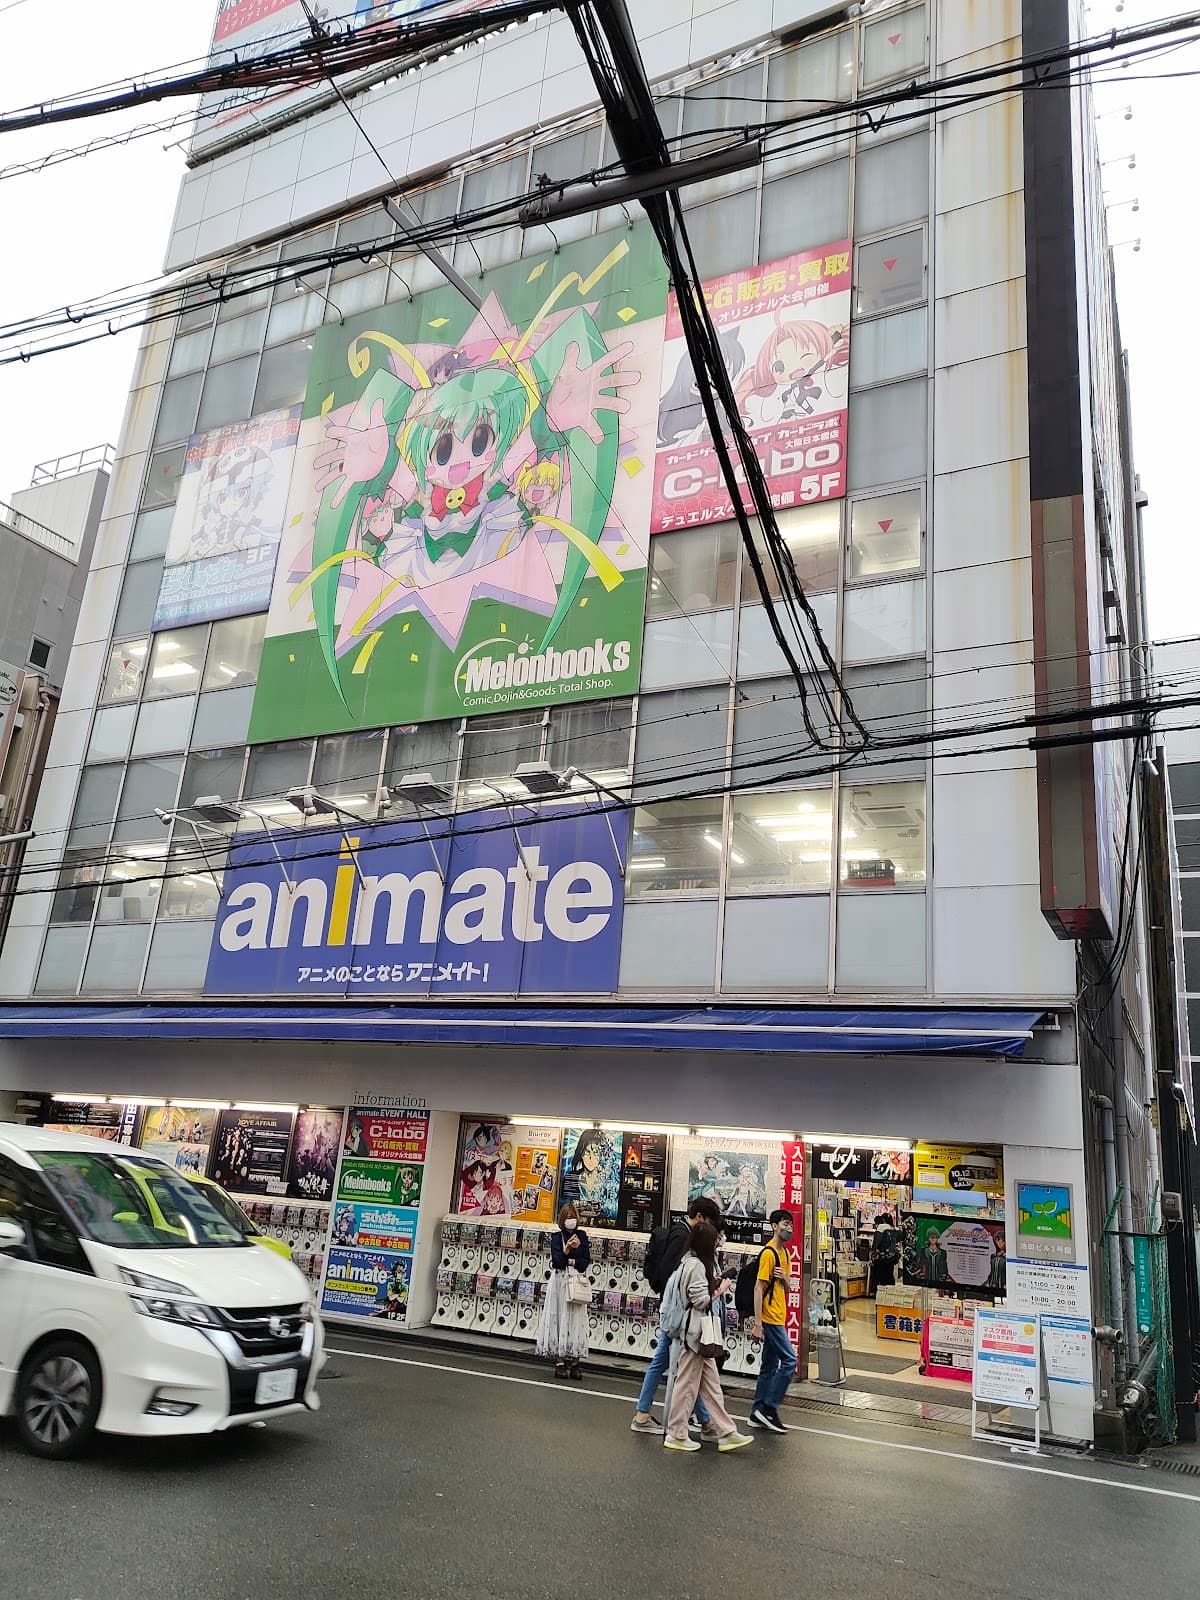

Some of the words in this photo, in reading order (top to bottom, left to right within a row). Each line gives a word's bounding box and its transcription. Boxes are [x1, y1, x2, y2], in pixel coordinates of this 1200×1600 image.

[800, 471, 841, 501] 5F
[464, 638, 631, 694] Melonbooks
[558, 681, 583, 694] Total
[585, 679, 614, 691] Shop.
[219, 836, 614, 952] animate
[353, 1091, 426, 1108] information
[380, 1109, 405, 1118] EVENT
[407, 1110, 428, 1119] HALL
[369, 1125, 425, 1140] C-labo
[344, 1175, 392, 1193] Melonbooks
[791, 1146, 803, 1205] 入口専用
[327, 1258, 388, 1284] animate
[396, 1313, 405, 1321] 2F
